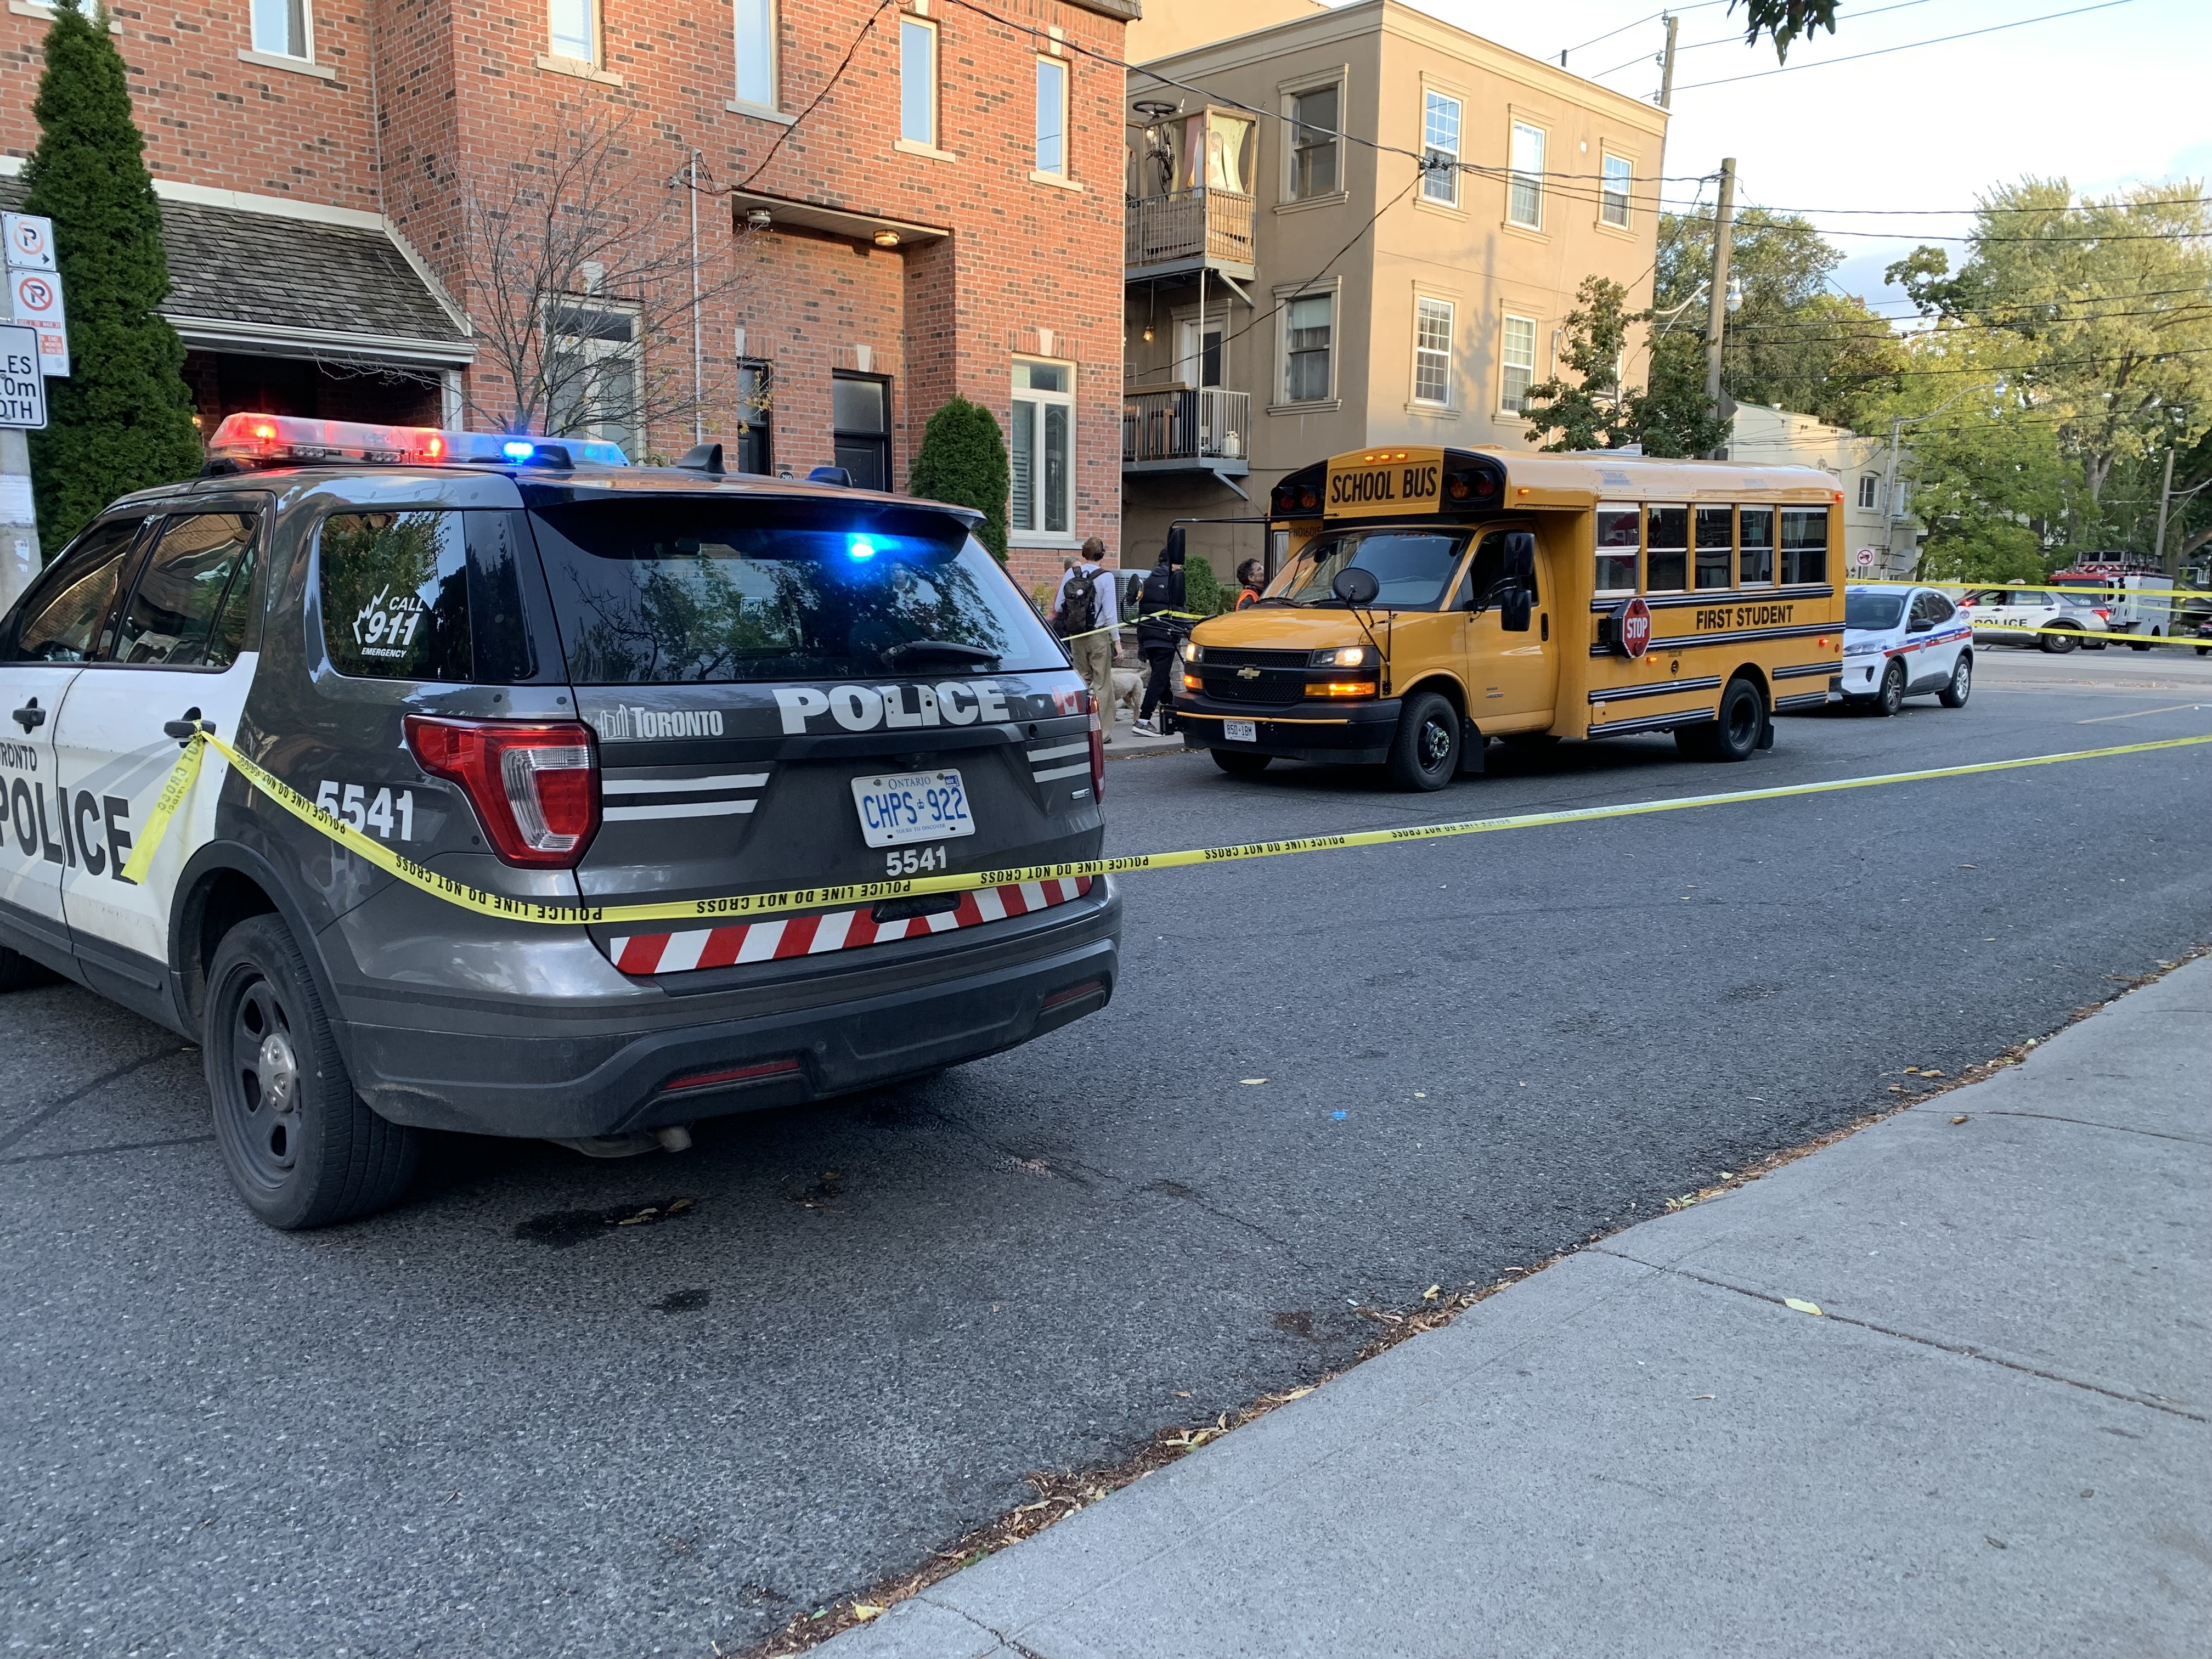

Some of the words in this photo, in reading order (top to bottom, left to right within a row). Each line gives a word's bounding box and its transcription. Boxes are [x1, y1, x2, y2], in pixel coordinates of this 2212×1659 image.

[0, 355, 31, 374] ES
[0, 377, 36, 397] 0m
[1331, 470, 1395, 504] SCHOOL
[1402, 466, 1437, 499] BUS
[389, 596, 424, 612] CALL
[1696, 608, 1733, 630] FIRST
[1736, 605, 1794, 627] STUDENT
[365, 611, 420, 646] 9-1-1
[1627, 617, 1648, 639] STOP
[361, 647, 407, 658] EMERGENCY
[771, 680, 1011, 734] POLICE
[630, 707, 724, 738] TORONTO
[0, 742, 37, 772] RONTO
[888, 776, 932, 790] ONTARIO
[315, 780, 414, 842] 5541
[863, 791, 918, 829] CHPS
[927, 787, 968, 821] 922
[922, 823, 946, 831] DISCOVER
[1243, 844, 1263, 855] NOT
[1266, 842, 1280, 852] DO
[1284, 839, 1307, 850] LINE
[1311, 836, 1345, 847] POLICE
[886, 845, 947, 877] 5541
[1204, 847, 1239, 860] CROSS
[396, 855, 432, 883] CROSS
[1056, 864, 1071, 876] DO
[1077, 860, 1103, 874] LINE
[1108, 856, 1149, 870] POLICE
[980, 869, 1022, 884] CROSS
[1026, 866, 1051, 879] NOT
[438, 876, 462, 896] NOT
[821, 885, 854, 901] LINE
[861, 880, 911, 896] POLICE
[469, 889, 486, 905] DO
[696, 896, 750, 914] CROSS
[757, 893, 788, 909] NOT
[794, 890, 814, 905] DO
[494, 896, 528, 916] LINE
[538, 906, 602, 921] POLICE
